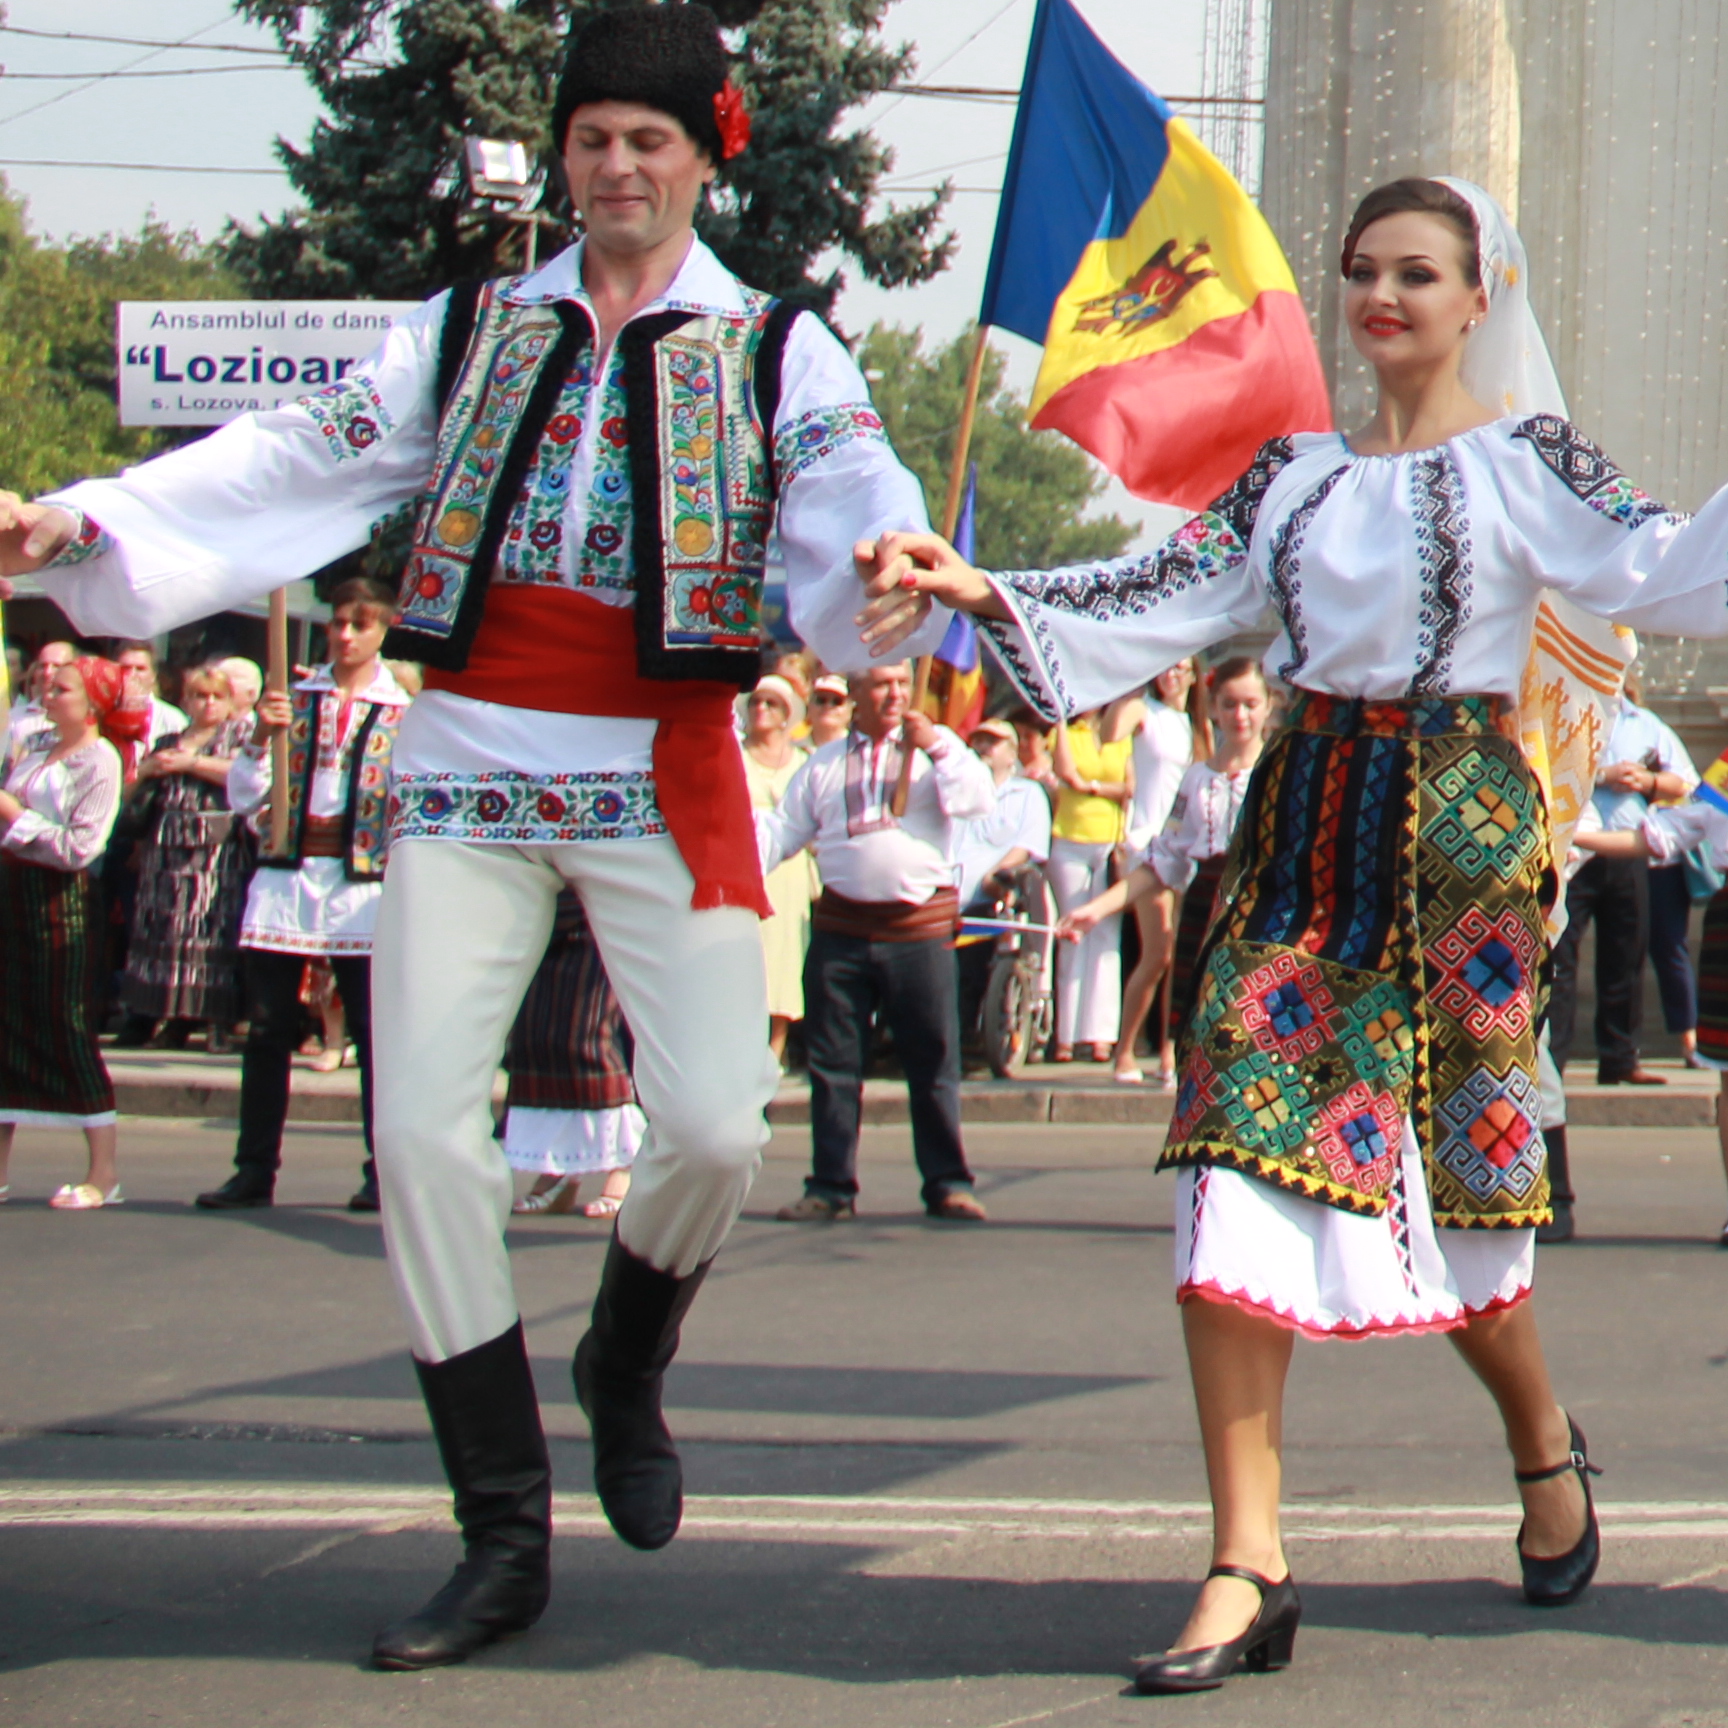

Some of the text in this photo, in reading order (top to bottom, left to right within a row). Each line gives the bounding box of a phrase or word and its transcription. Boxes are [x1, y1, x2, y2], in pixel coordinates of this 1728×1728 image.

[151, 309, 392, 329] Ansamblul de dans
[151, 397, 170, 410] s.
